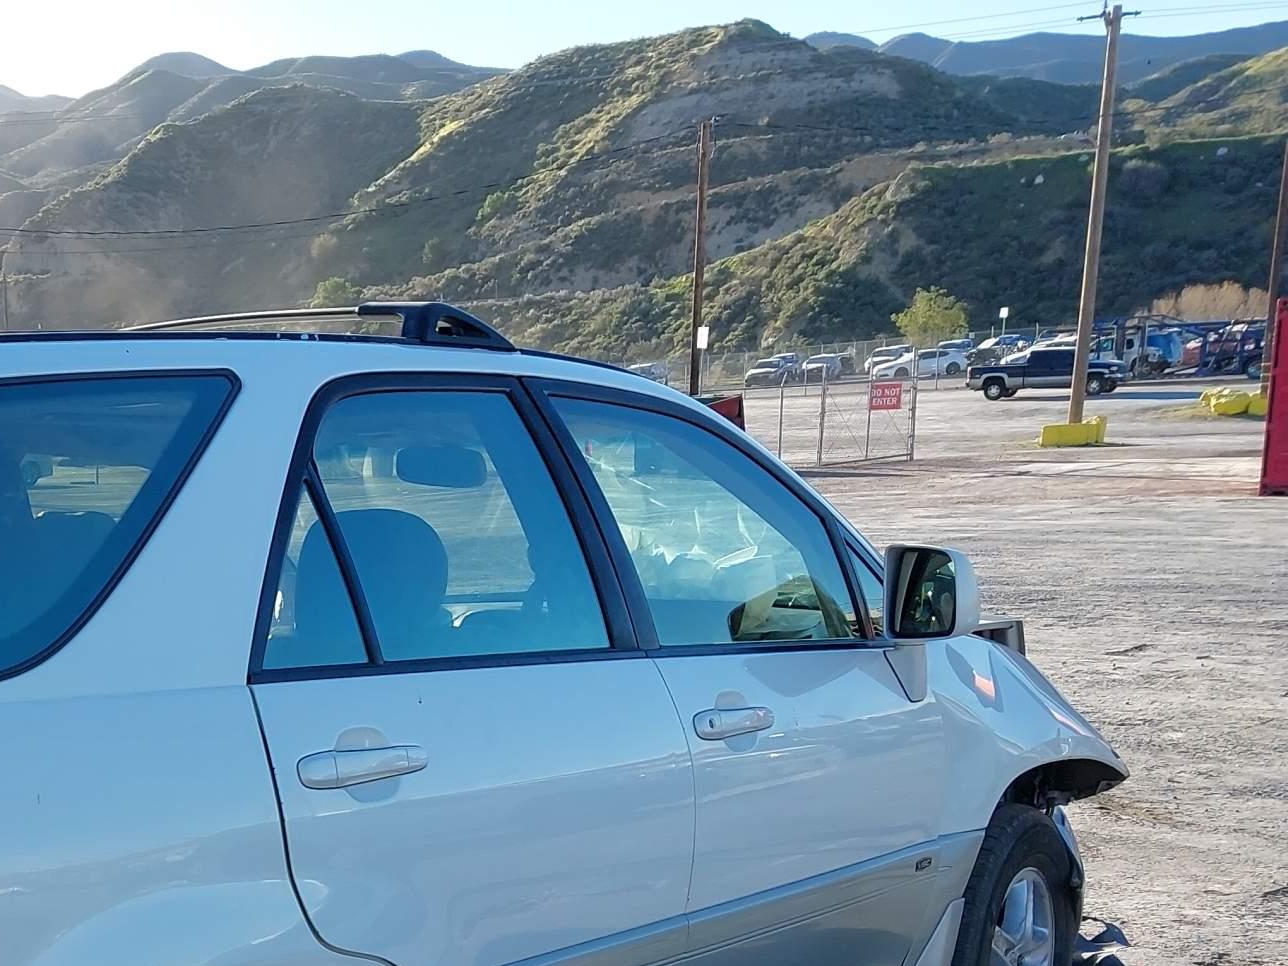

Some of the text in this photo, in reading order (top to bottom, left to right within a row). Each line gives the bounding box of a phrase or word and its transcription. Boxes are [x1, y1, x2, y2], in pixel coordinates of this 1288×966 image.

[872, 387, 901, 397] DO NOT
[872, 397, 898, 406] ENTER
